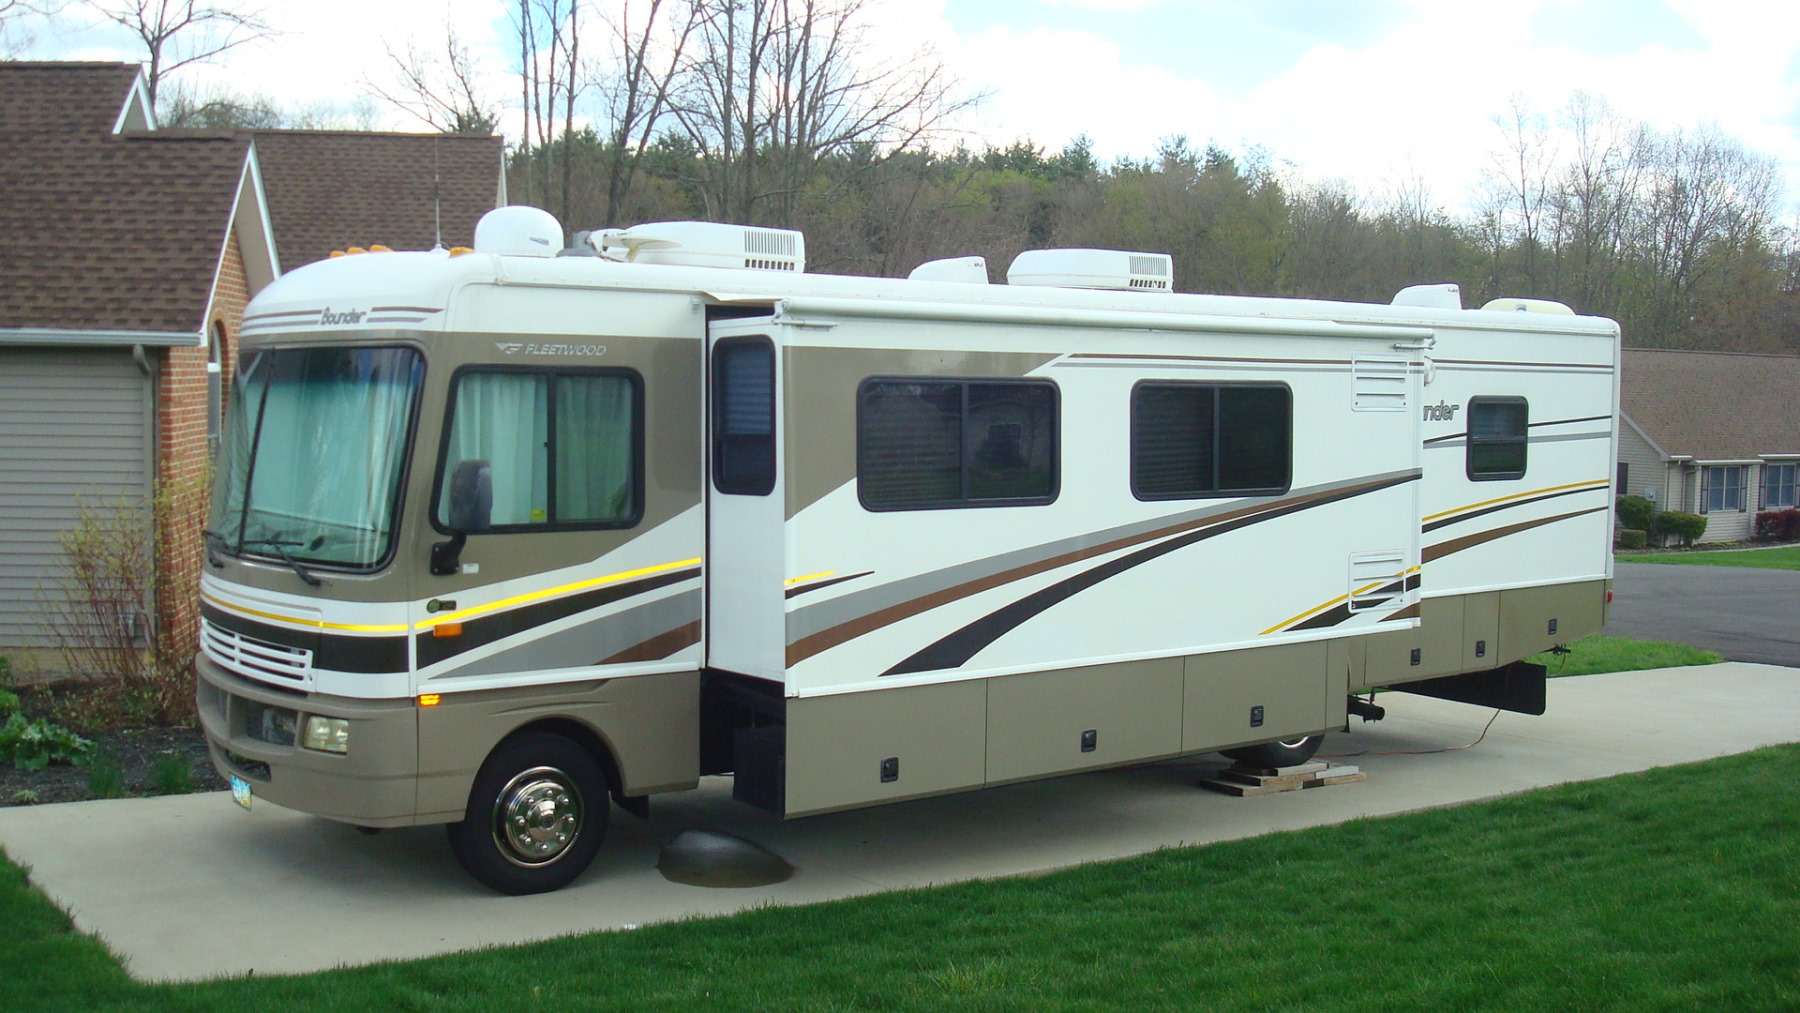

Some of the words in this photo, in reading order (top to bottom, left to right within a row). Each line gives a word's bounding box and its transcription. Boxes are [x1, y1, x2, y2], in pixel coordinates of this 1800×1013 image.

[320, 306, 367, 326] Bounder
[524, 343, 607, 356] FLEETWOOD
[1423, 399, 1460, 421] nder
